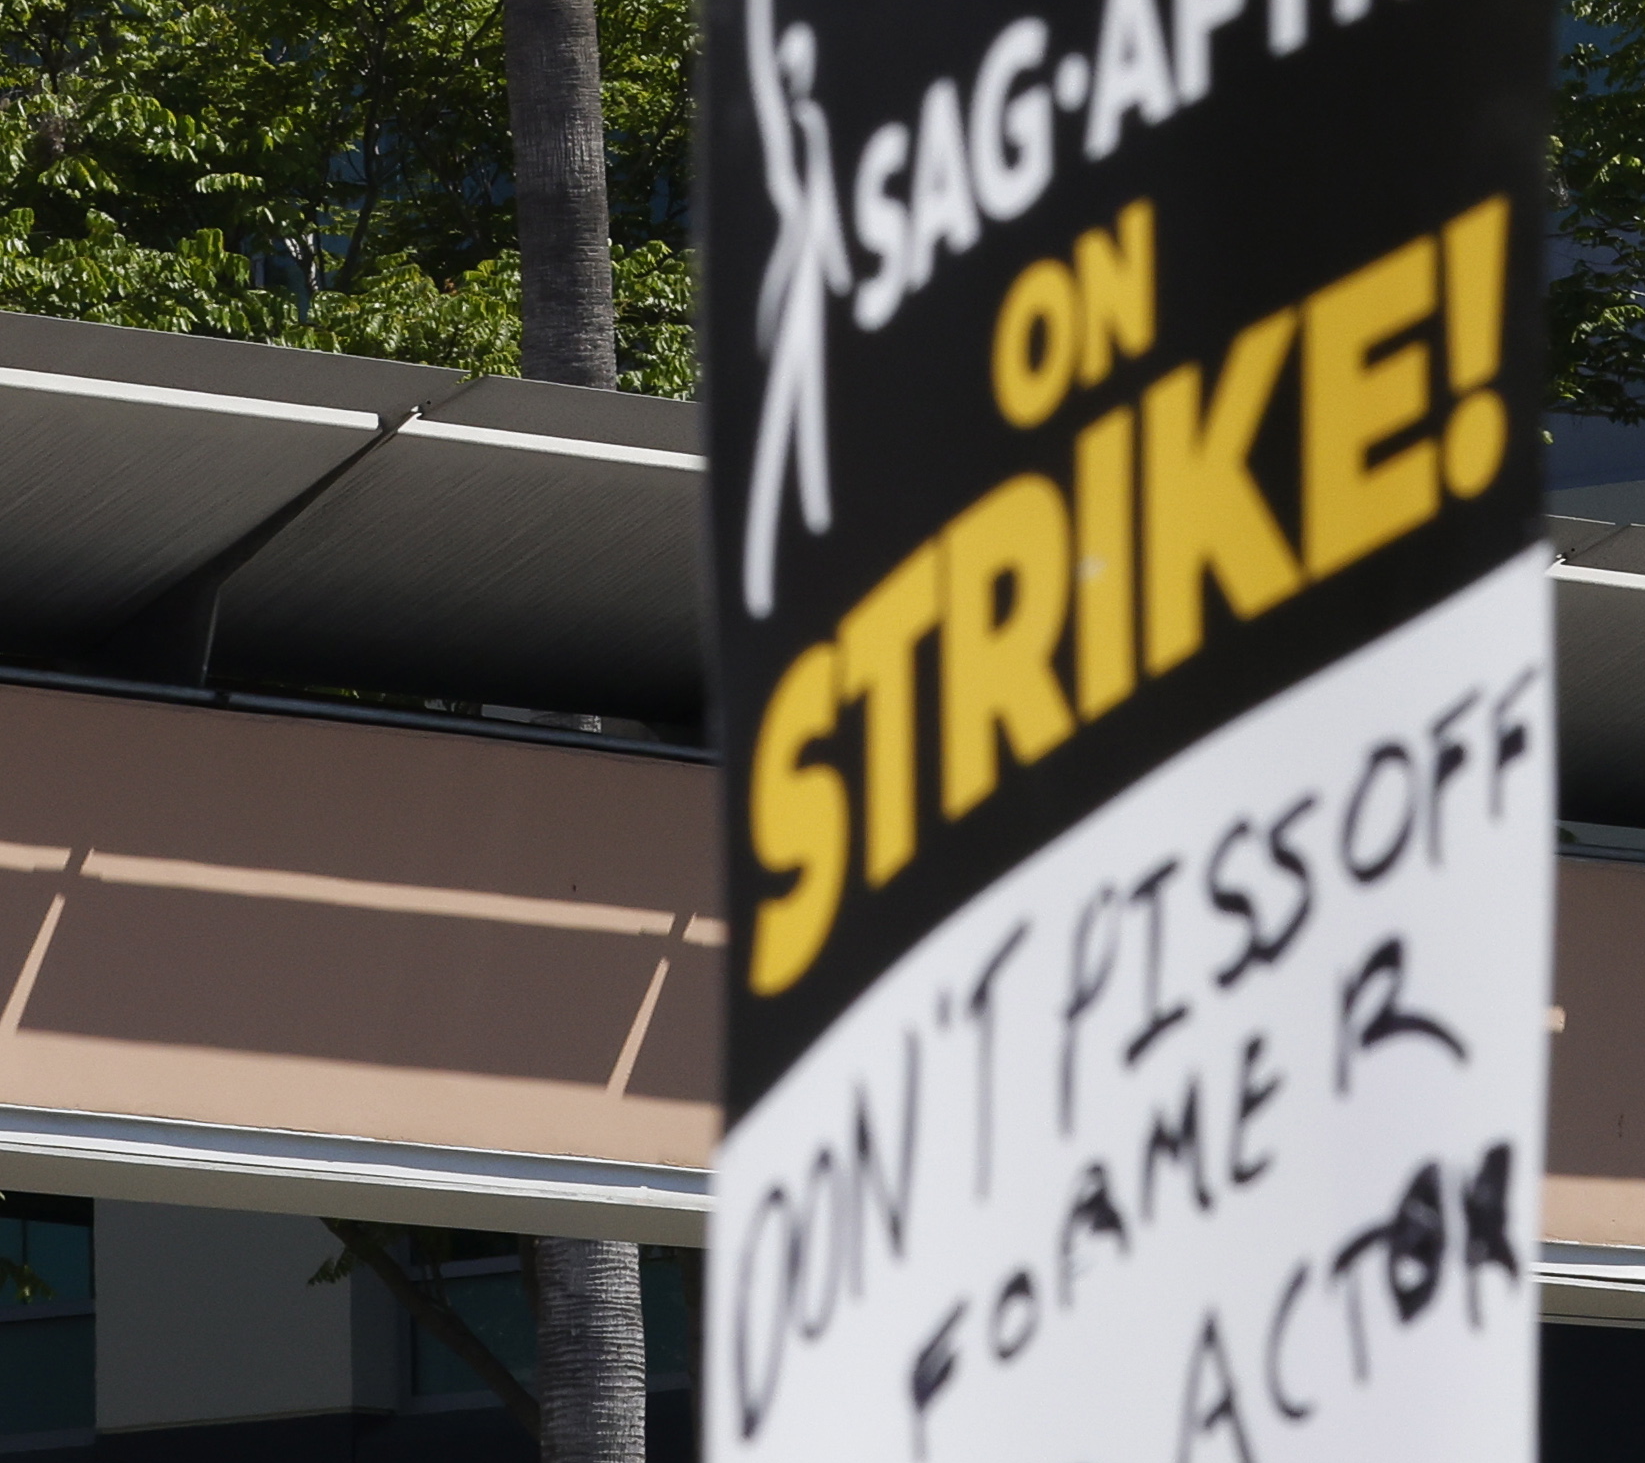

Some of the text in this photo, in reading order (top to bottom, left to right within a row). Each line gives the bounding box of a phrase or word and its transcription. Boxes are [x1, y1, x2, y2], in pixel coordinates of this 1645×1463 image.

[992, 197, 1155, 427] ON
[748, 196, 1509, 997] STRIKE!
[731, 920, 1024, 1442] DON'T
